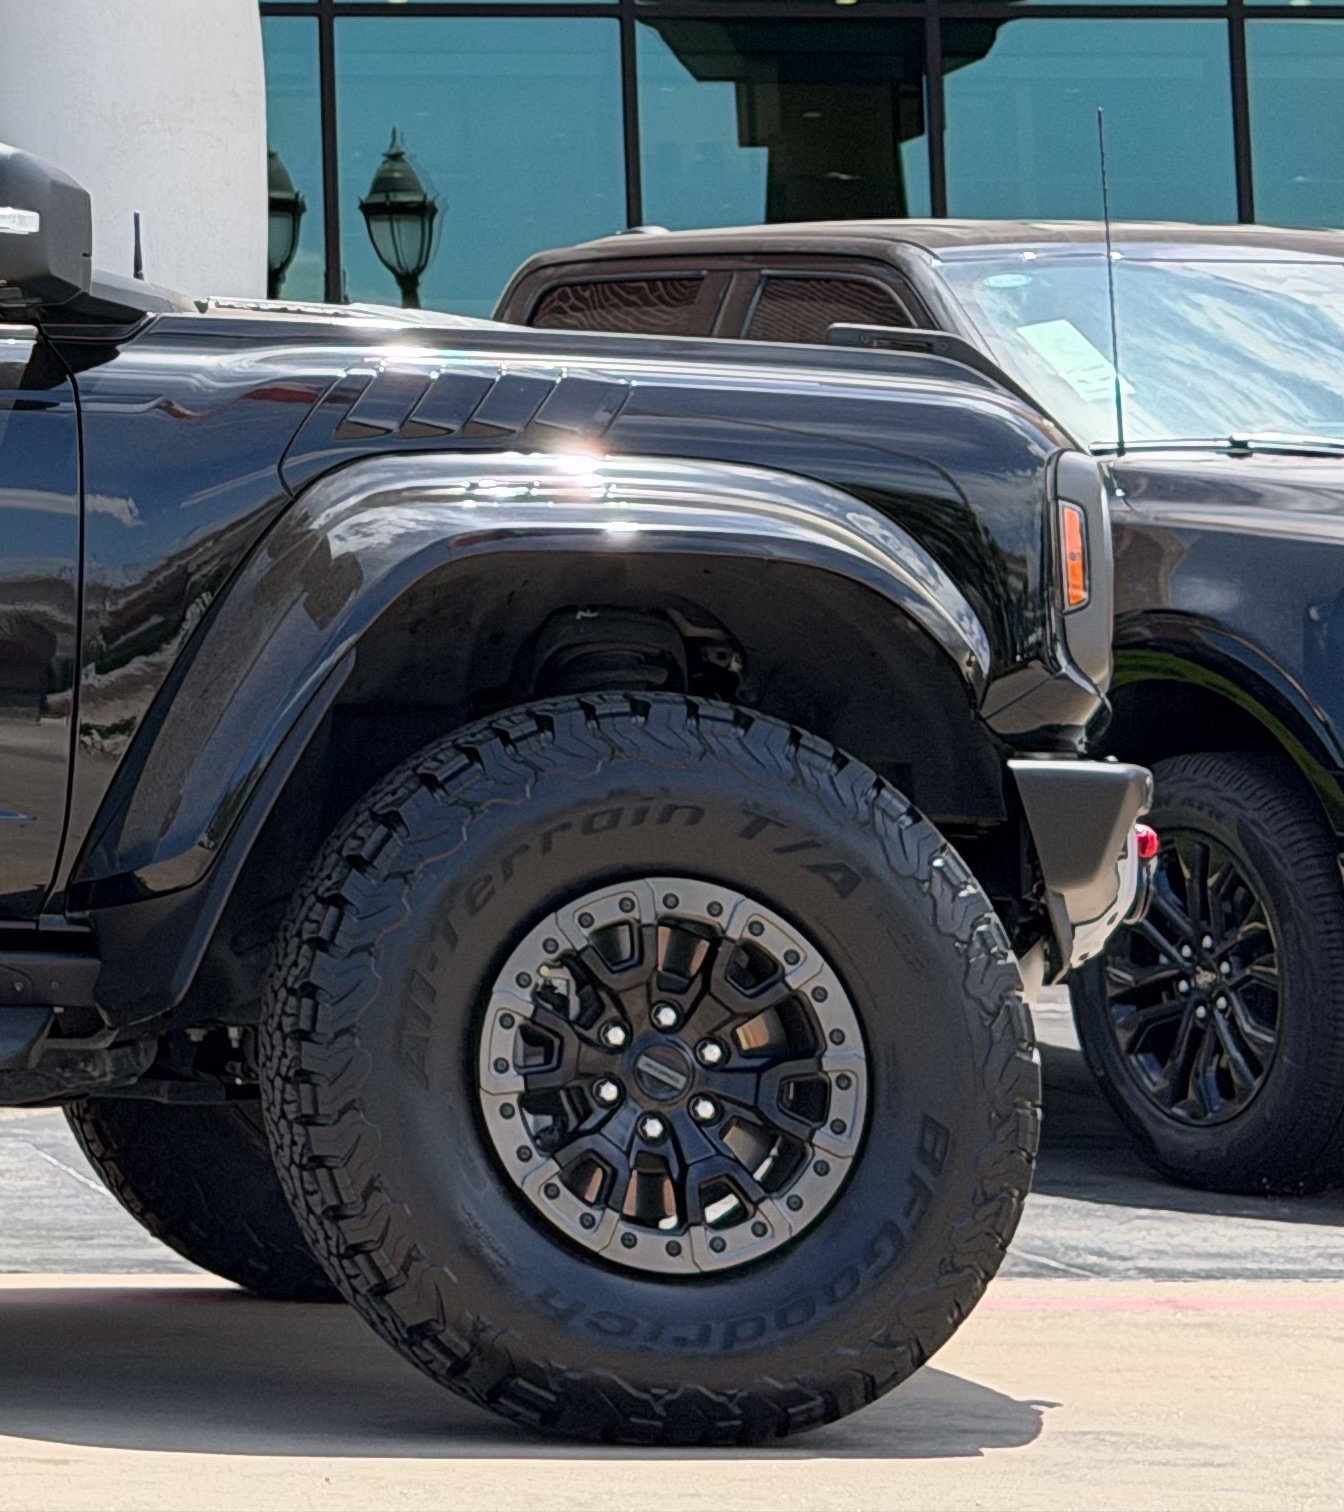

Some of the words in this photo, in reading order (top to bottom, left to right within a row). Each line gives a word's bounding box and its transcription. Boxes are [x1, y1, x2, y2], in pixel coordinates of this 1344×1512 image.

[397, 792, 707, 1082] All-Terrain
[734, 800, 873, 901] T/A
[537, 1113, 952, 1356] BFGoodrich
